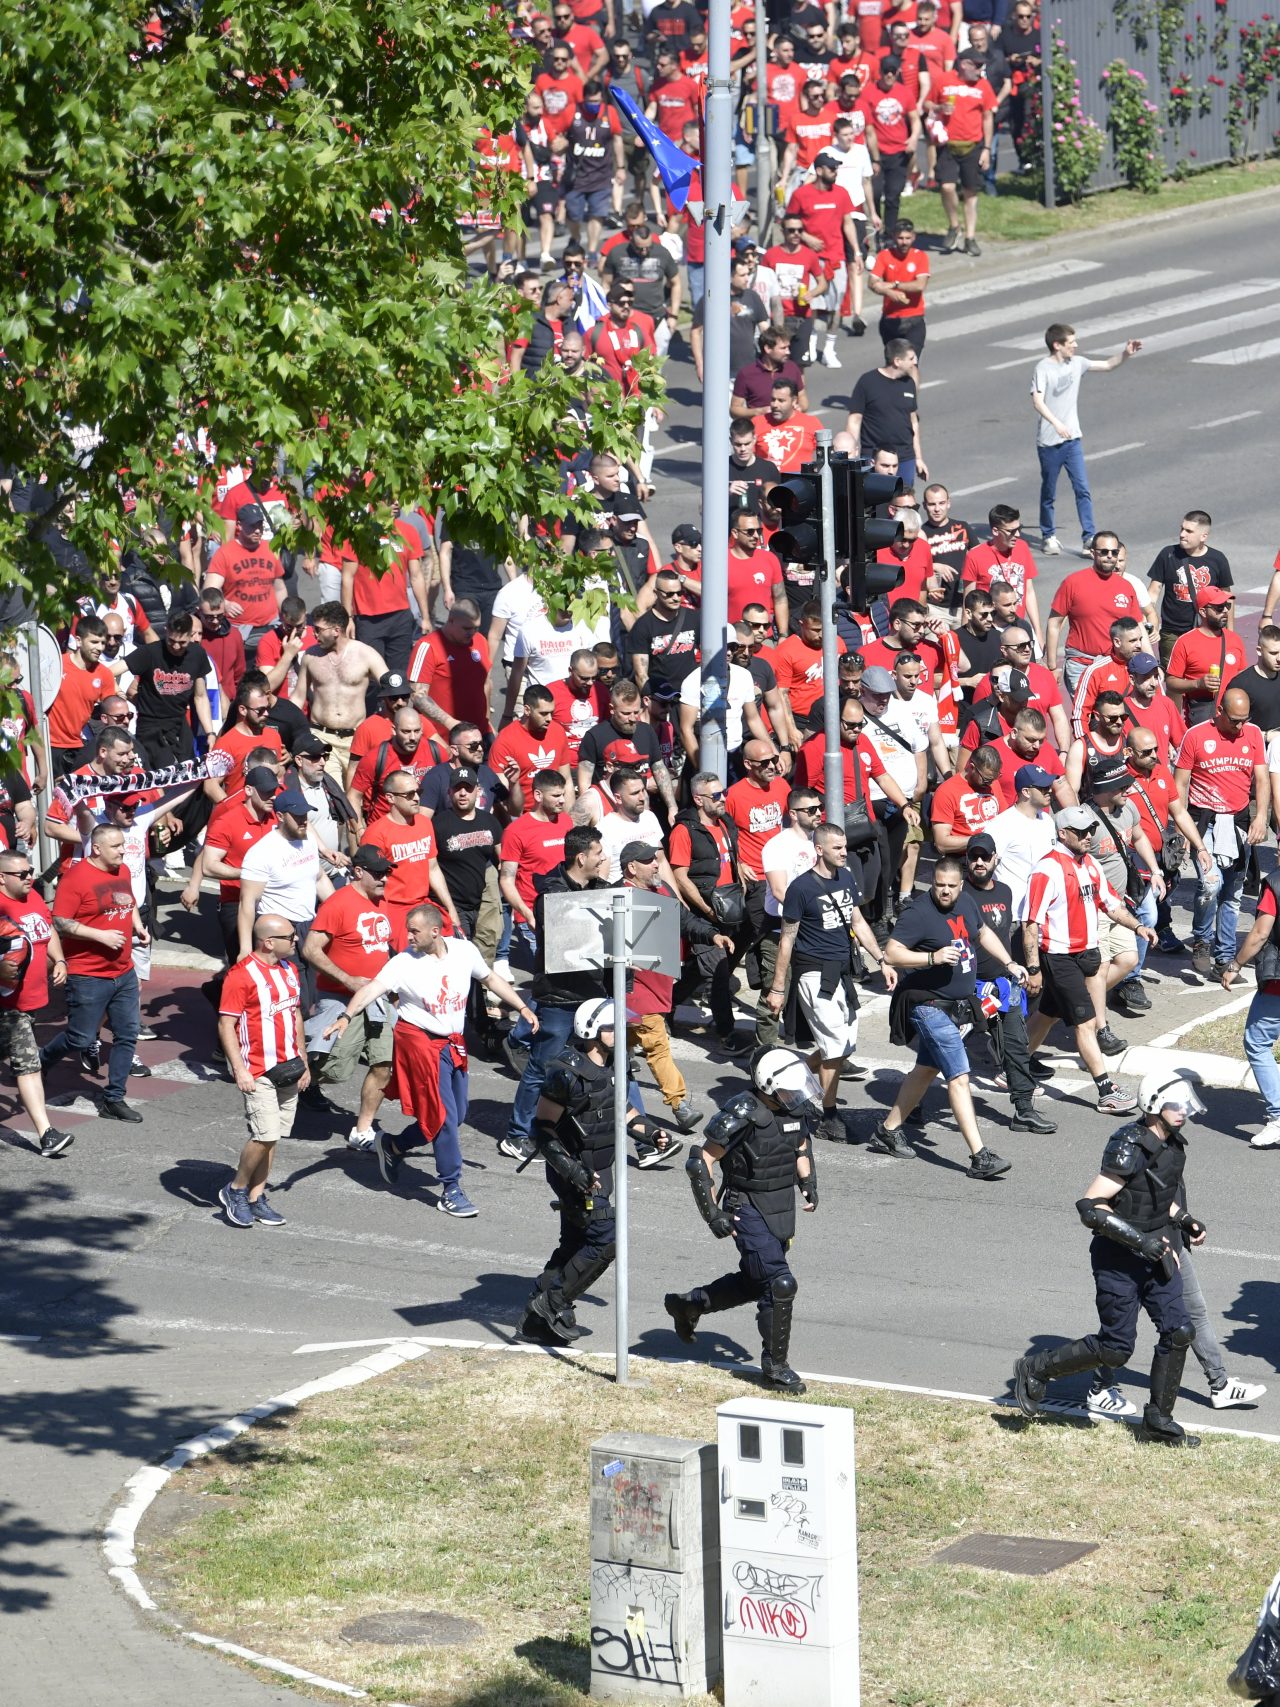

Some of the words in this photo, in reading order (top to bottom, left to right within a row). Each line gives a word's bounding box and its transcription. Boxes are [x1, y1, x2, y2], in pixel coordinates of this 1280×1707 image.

[233, 558, 274, 574] SUPER
[1200, 757, 1253, 769] OLYMPIACOS
[981, 904, 1007, 912] HUGO
